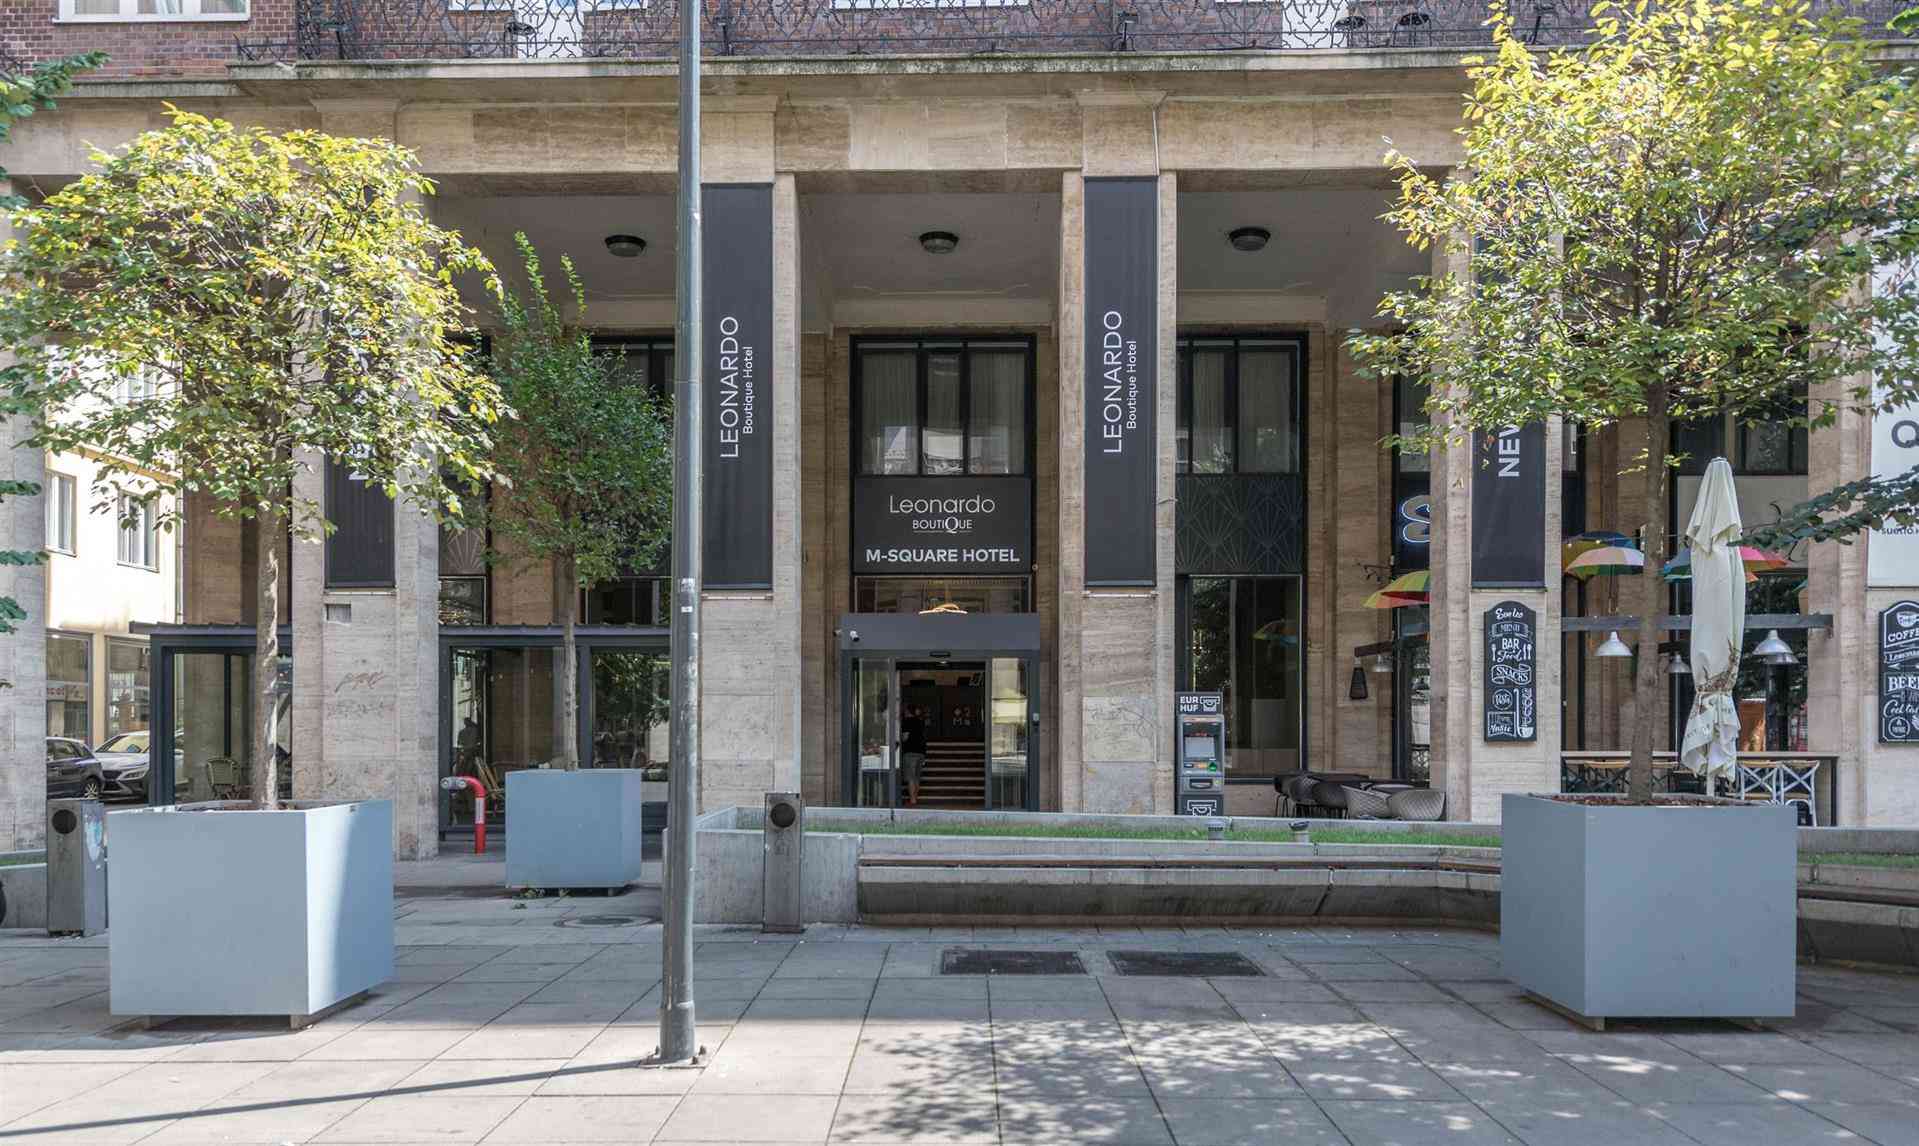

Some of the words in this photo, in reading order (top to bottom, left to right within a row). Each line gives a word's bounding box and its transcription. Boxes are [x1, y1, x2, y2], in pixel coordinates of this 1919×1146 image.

[742, 346, 753, 378] Hotel
[1126, 341, 1137, 373] Hotel
[720, 316, 739, 458] LEONARDO
[1103, 311, 1122, 453] LEONARDO
[742, 382, 756, 434] Boutique
[1126, 376, 1140, 429] Boutique
[889, 494, 996, 514] Leonardo
[865, 549, 958, 562] M-SQUARE
[963, 549, 1020, 562] HOTEL
[1501, 637, 1520, 650] BAR
[1496, 665, 1529, 682] SNACKS
[1888, 675, 1919, 692] BEE
[1180, 696, 1199, 704] EUR
[1180, 704, 1199, 712] HUF
